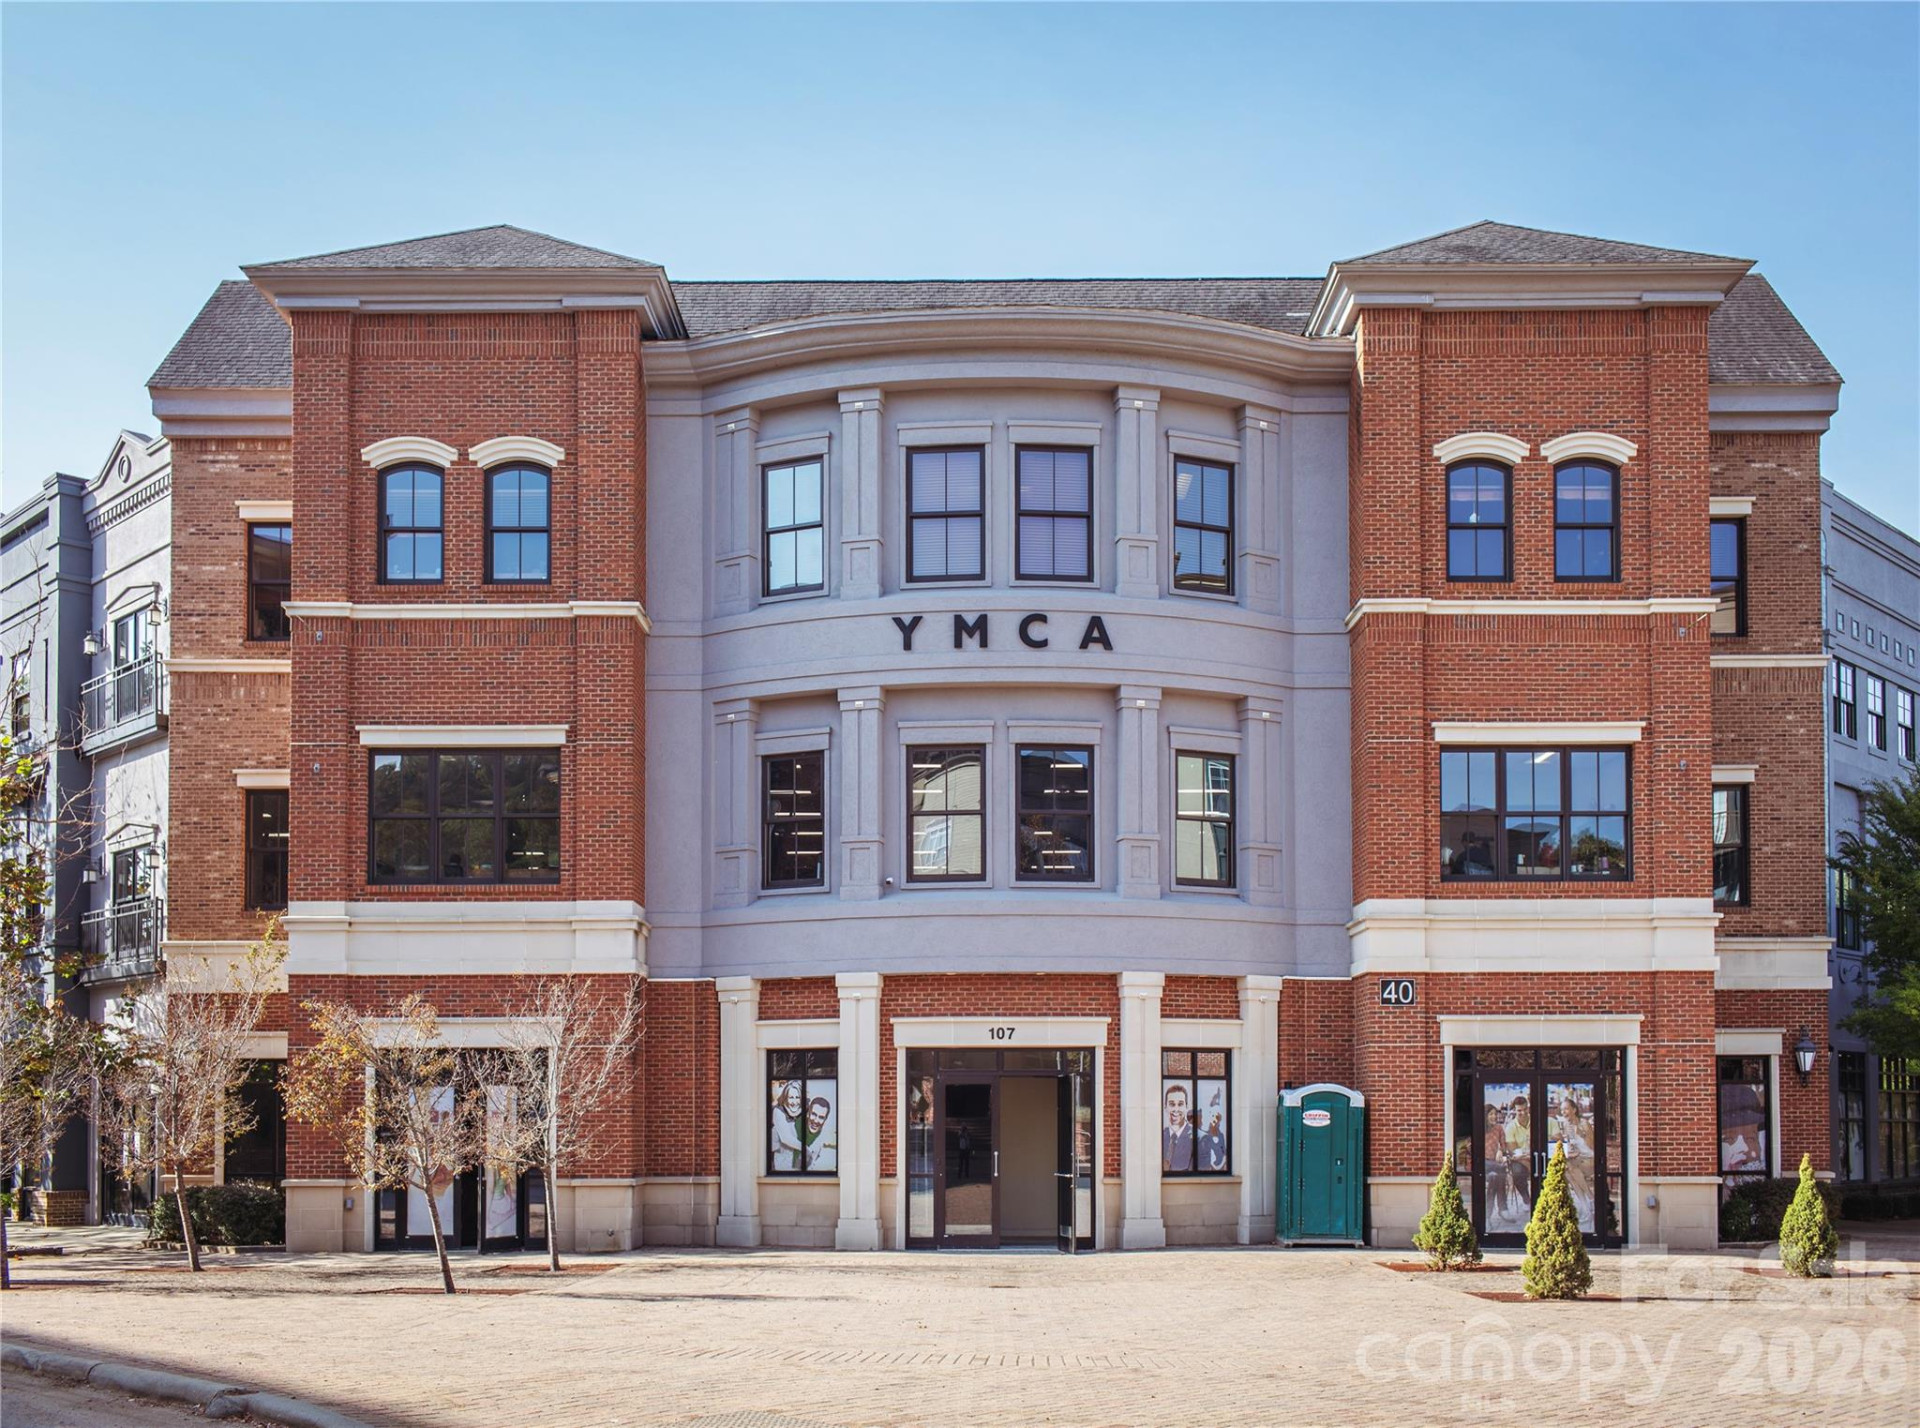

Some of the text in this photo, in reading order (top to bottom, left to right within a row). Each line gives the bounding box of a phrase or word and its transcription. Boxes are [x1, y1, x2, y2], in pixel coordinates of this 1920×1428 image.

[892, 613, 1113, 650] YMCA
[1383, 981, 1413, 1003] 40
[989, 1027, 1015, 1040] 107
